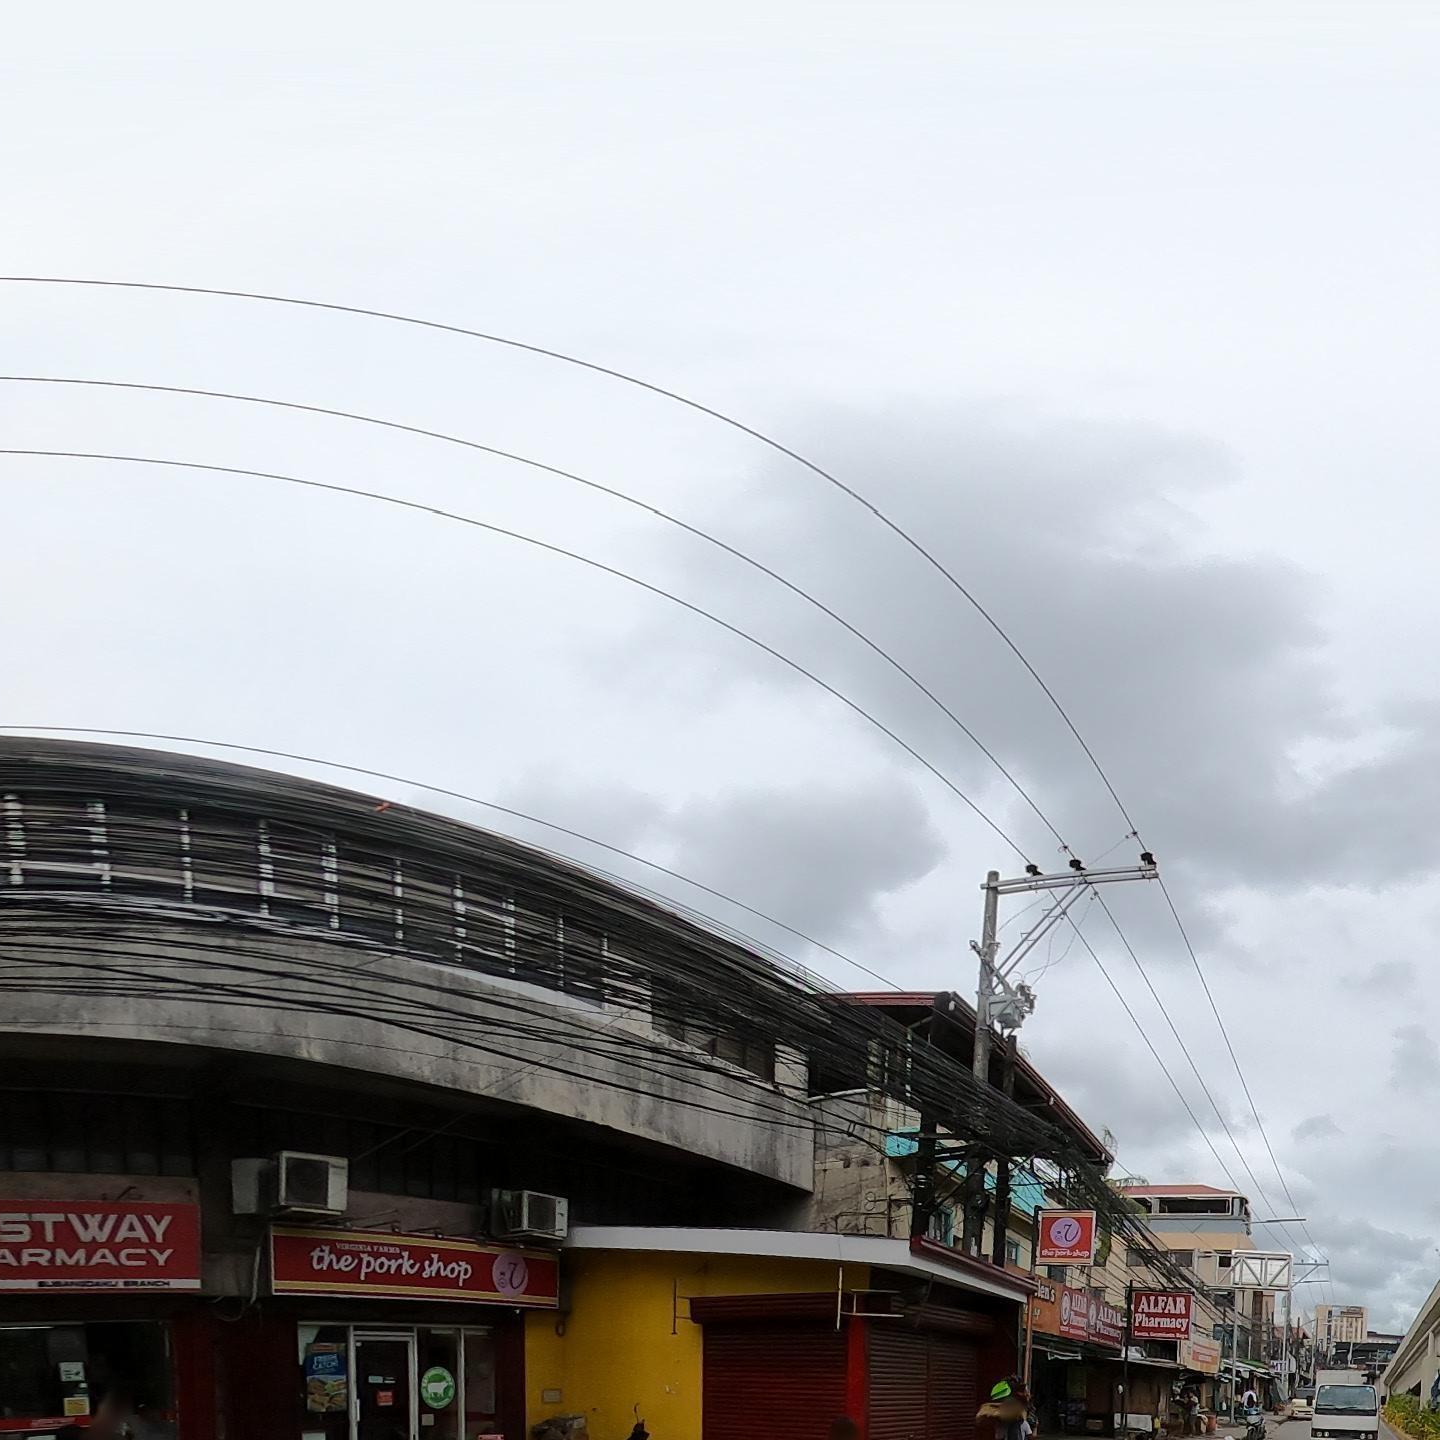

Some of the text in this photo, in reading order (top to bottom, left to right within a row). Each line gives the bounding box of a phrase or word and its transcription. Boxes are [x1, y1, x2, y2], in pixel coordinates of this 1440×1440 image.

[309, 1244, 473, 1287] the pork shop
[1138, 1295, 1186, 1314] ALFAR
[1134, 1313, 1189, 1332] Pharmacy
